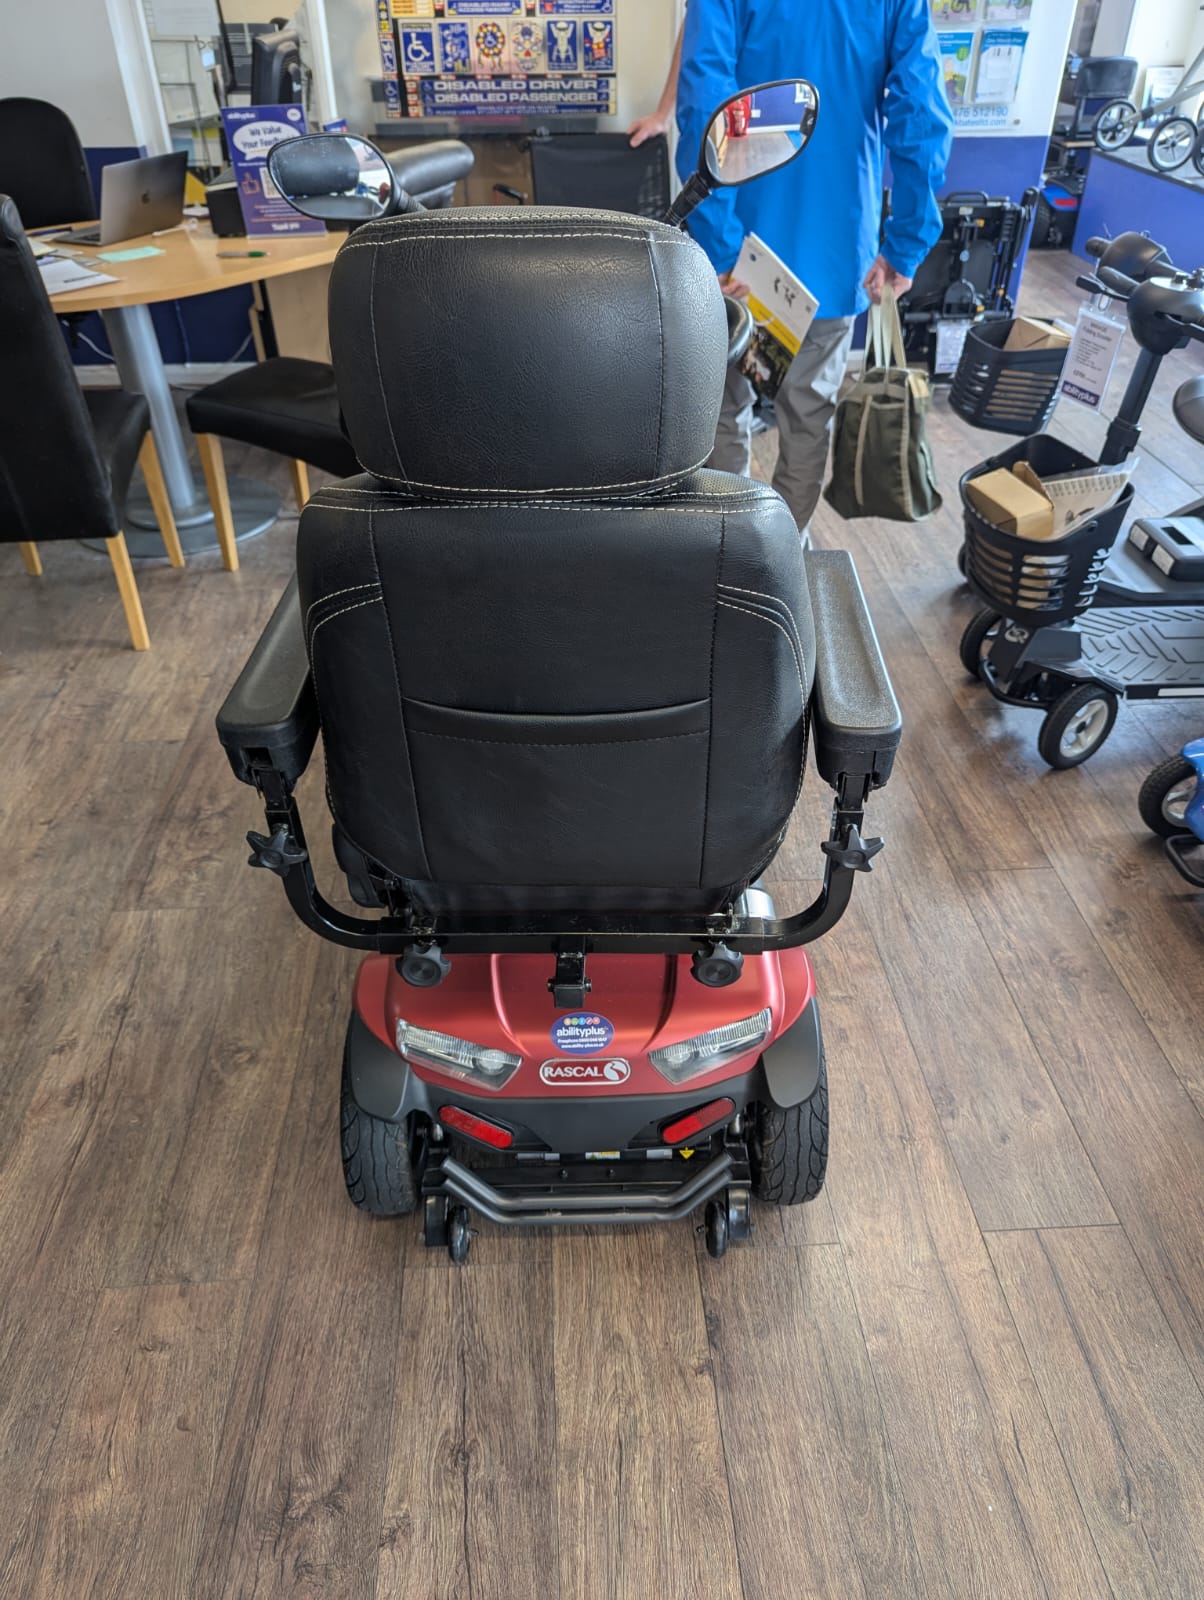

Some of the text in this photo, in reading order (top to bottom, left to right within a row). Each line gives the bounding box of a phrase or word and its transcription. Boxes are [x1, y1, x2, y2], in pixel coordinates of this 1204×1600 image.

[433, 80, 598, 91] DISABLED DRIVER
[434, 92, 598, 103] DISABLED PASSENGER
[1063, 384, 1096, 404] abilityplus
[557, 1026, 606, 1037] abilityplus
[544, 1066, 603, 1078] RASCAL
